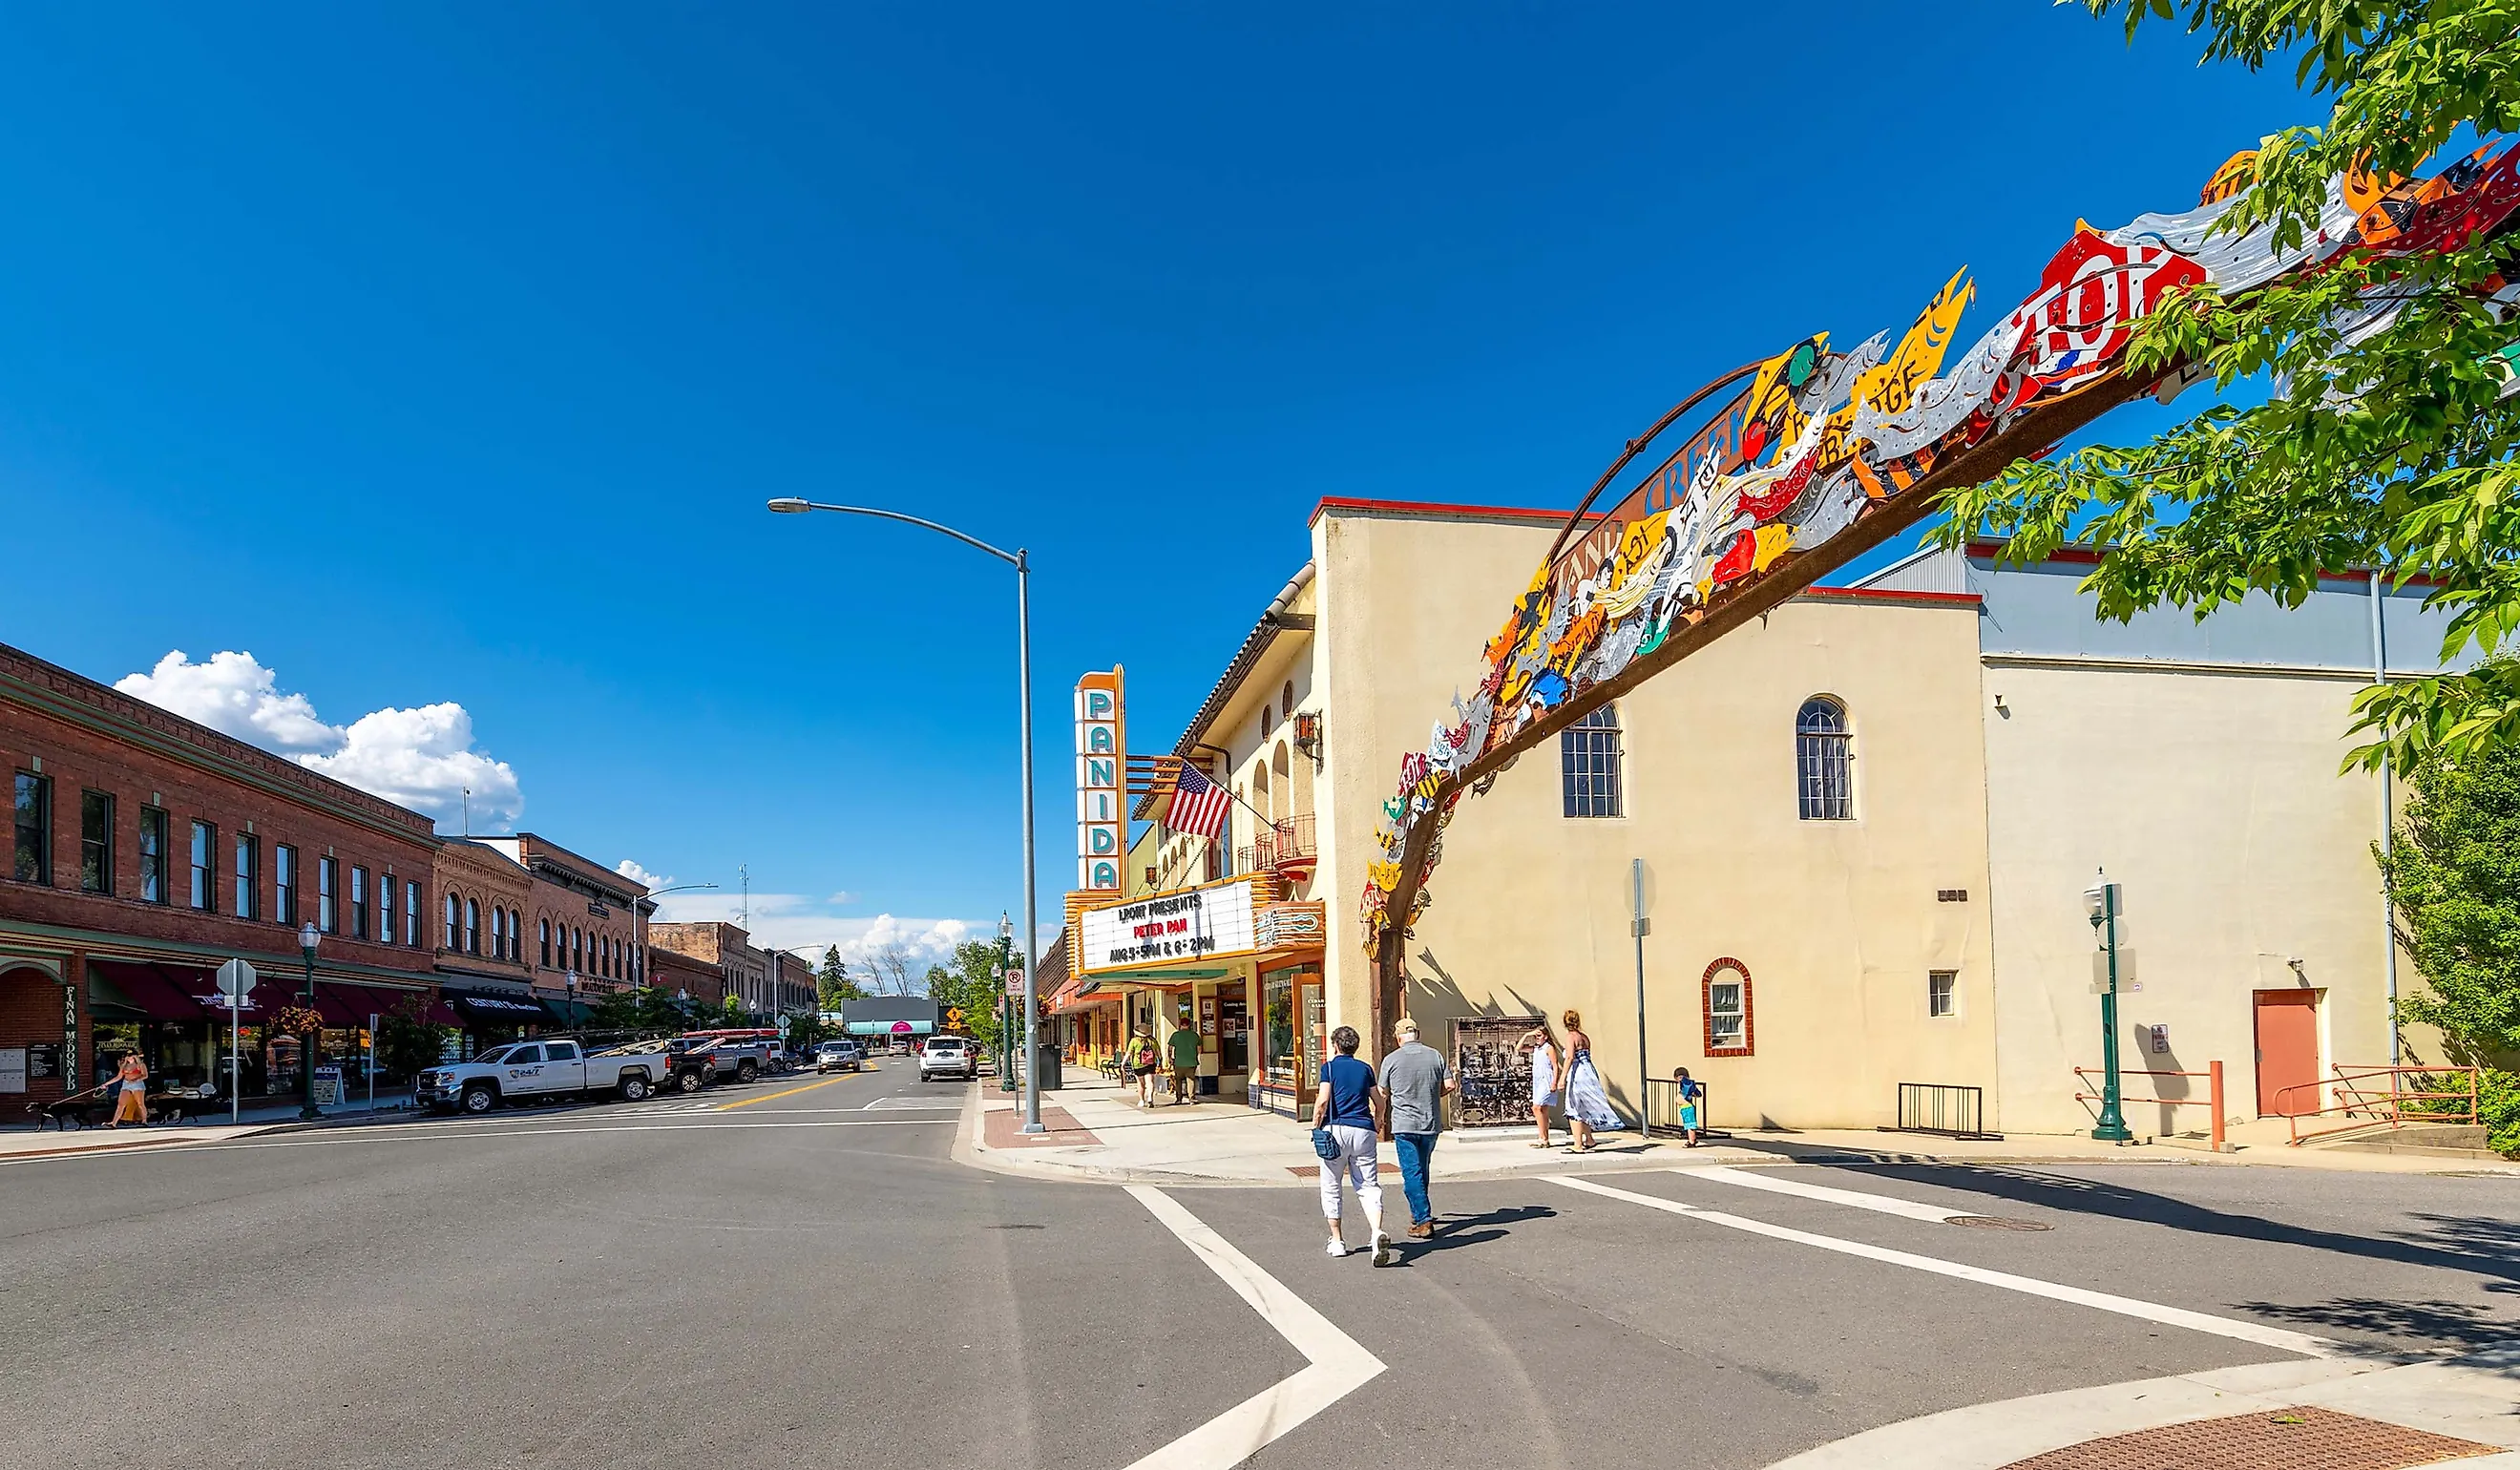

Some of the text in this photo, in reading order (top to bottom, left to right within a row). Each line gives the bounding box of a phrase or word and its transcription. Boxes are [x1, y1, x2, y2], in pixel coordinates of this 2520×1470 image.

[1089, 692, 1117, 889] PANIDA
[1148, 893, 1203, 917] PRESENTS
[1133, 917, 1188, 939] PETER PAN
[1110, 948, 1128, 963] AUG
[1164, 941, 1172, 956] &
[66, 986, 75, 1025] FINAN
